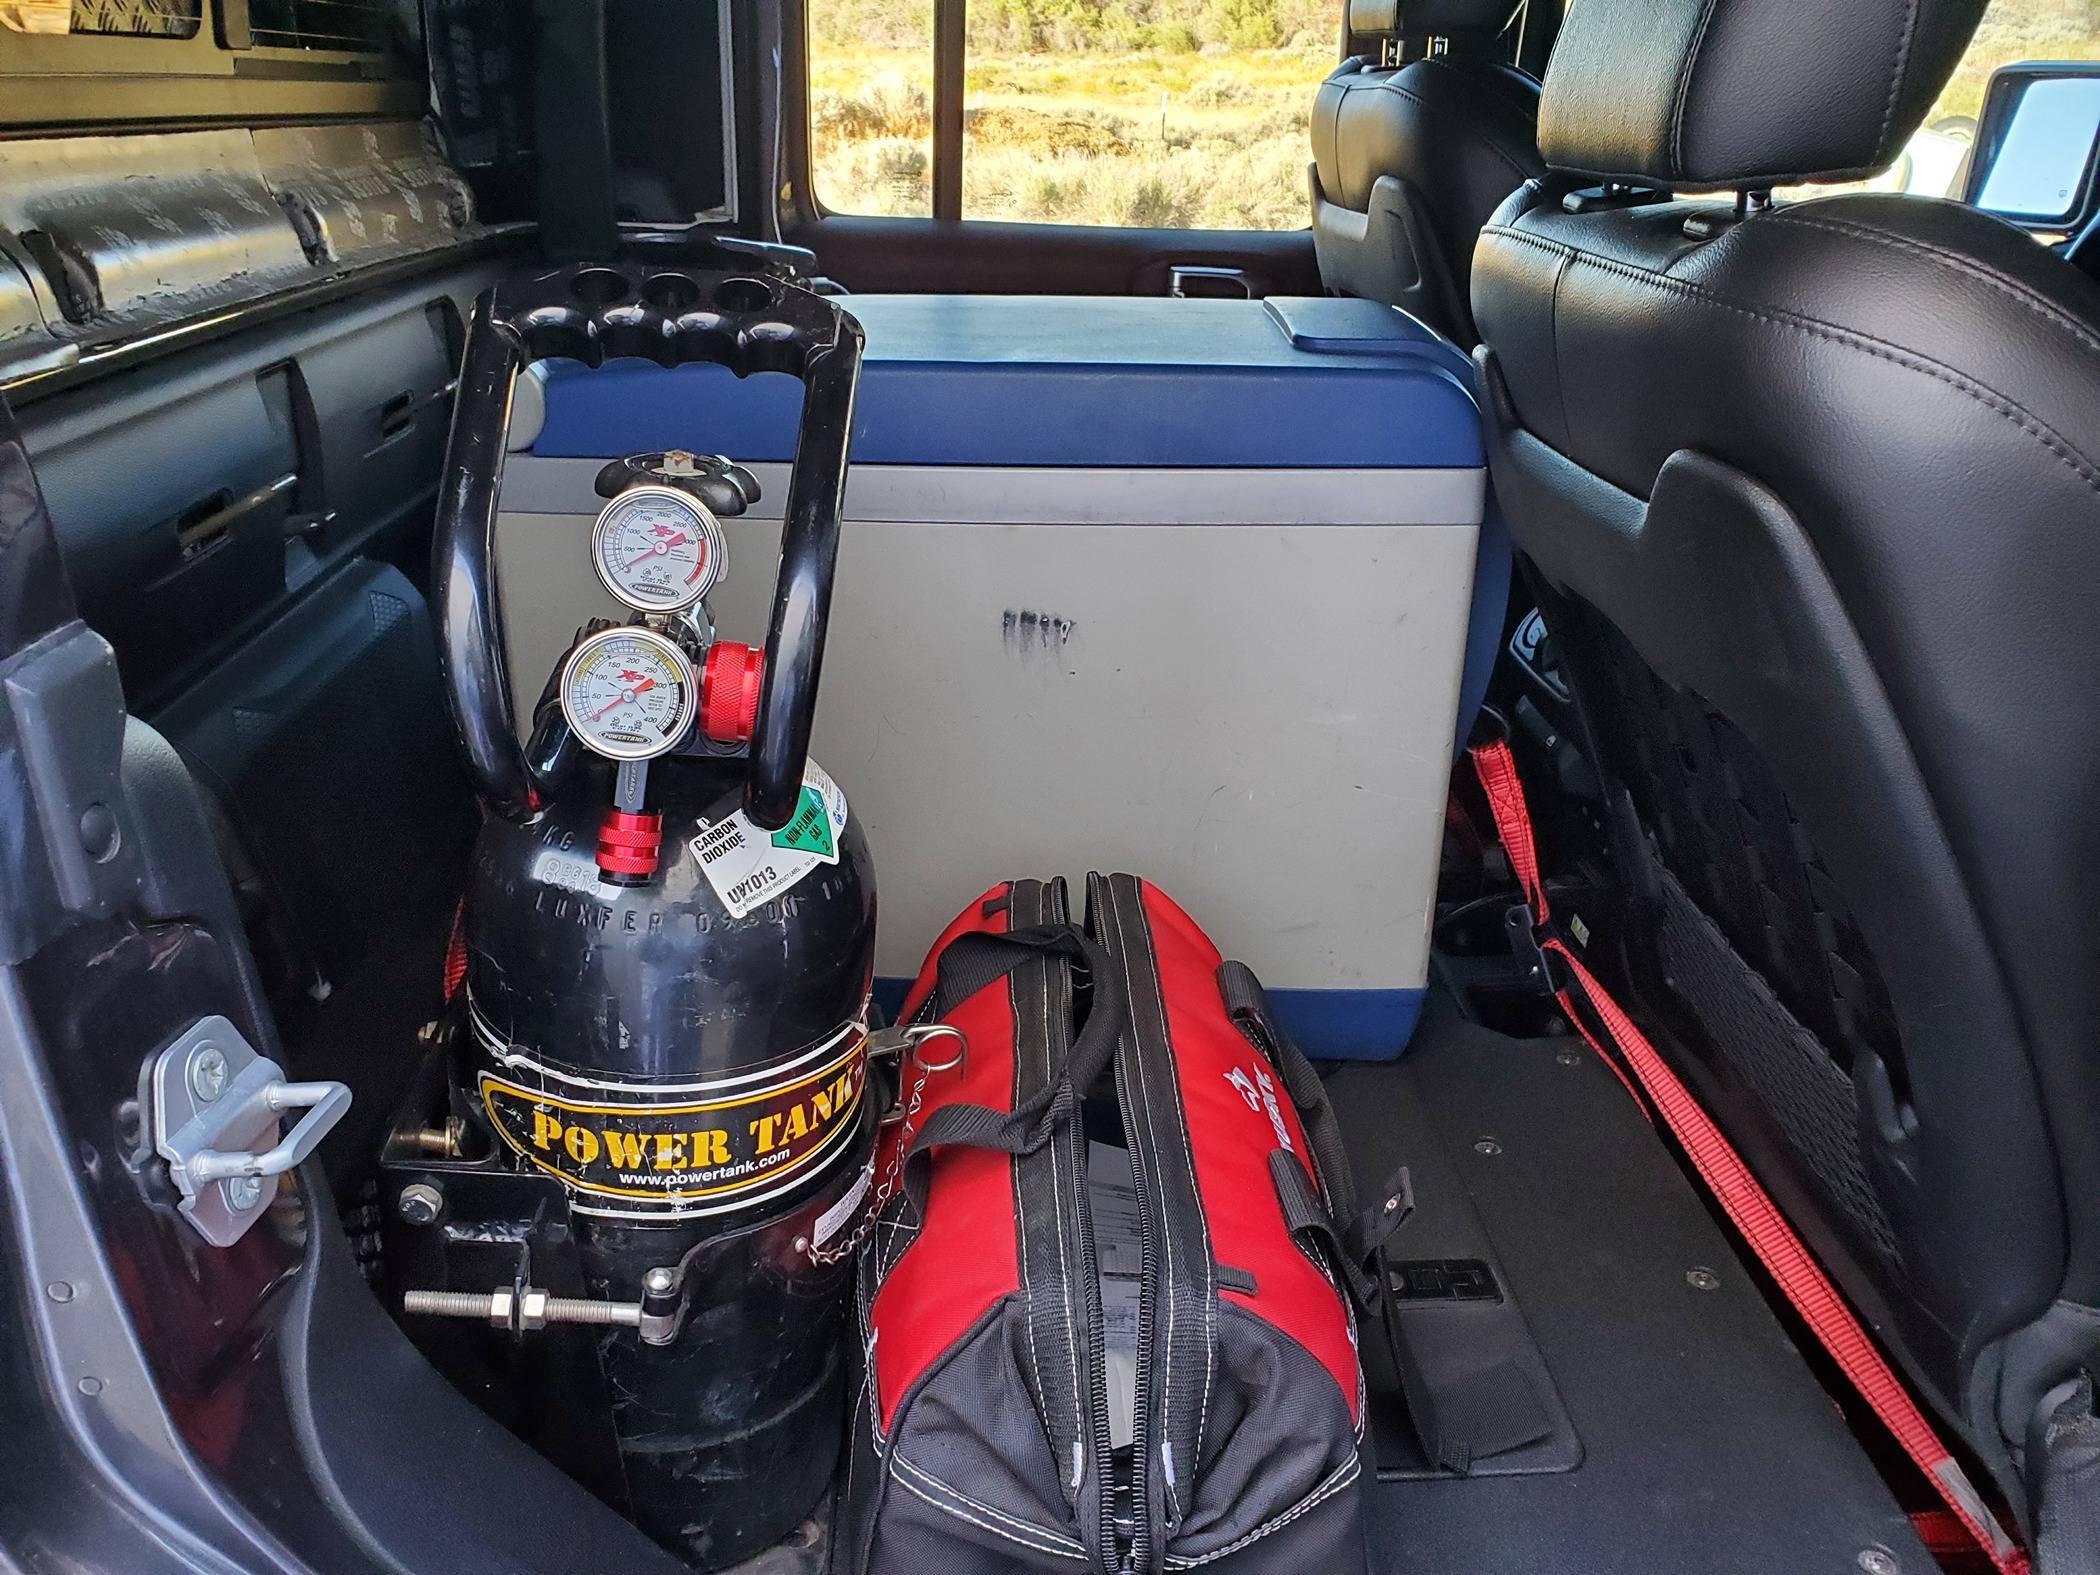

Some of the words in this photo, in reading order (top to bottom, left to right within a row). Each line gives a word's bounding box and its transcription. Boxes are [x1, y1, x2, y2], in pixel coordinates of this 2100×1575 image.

[644, 666, 658, 674] 250
[644, 716, 658, 724] 400
[694, 819, 738, 852] CARBON
[808, 824, 823, 842] GAS
[702, 832, 746, 864] DIOXIDE
[822, 840, 830, 852] 2
[789, 866, 802, 880] LABEL
[532, 1108, 732, 1172] POWER
[750, 1063, 854, 1157] TANK
[618, 1147, 790, 1186] www.powertank.com
